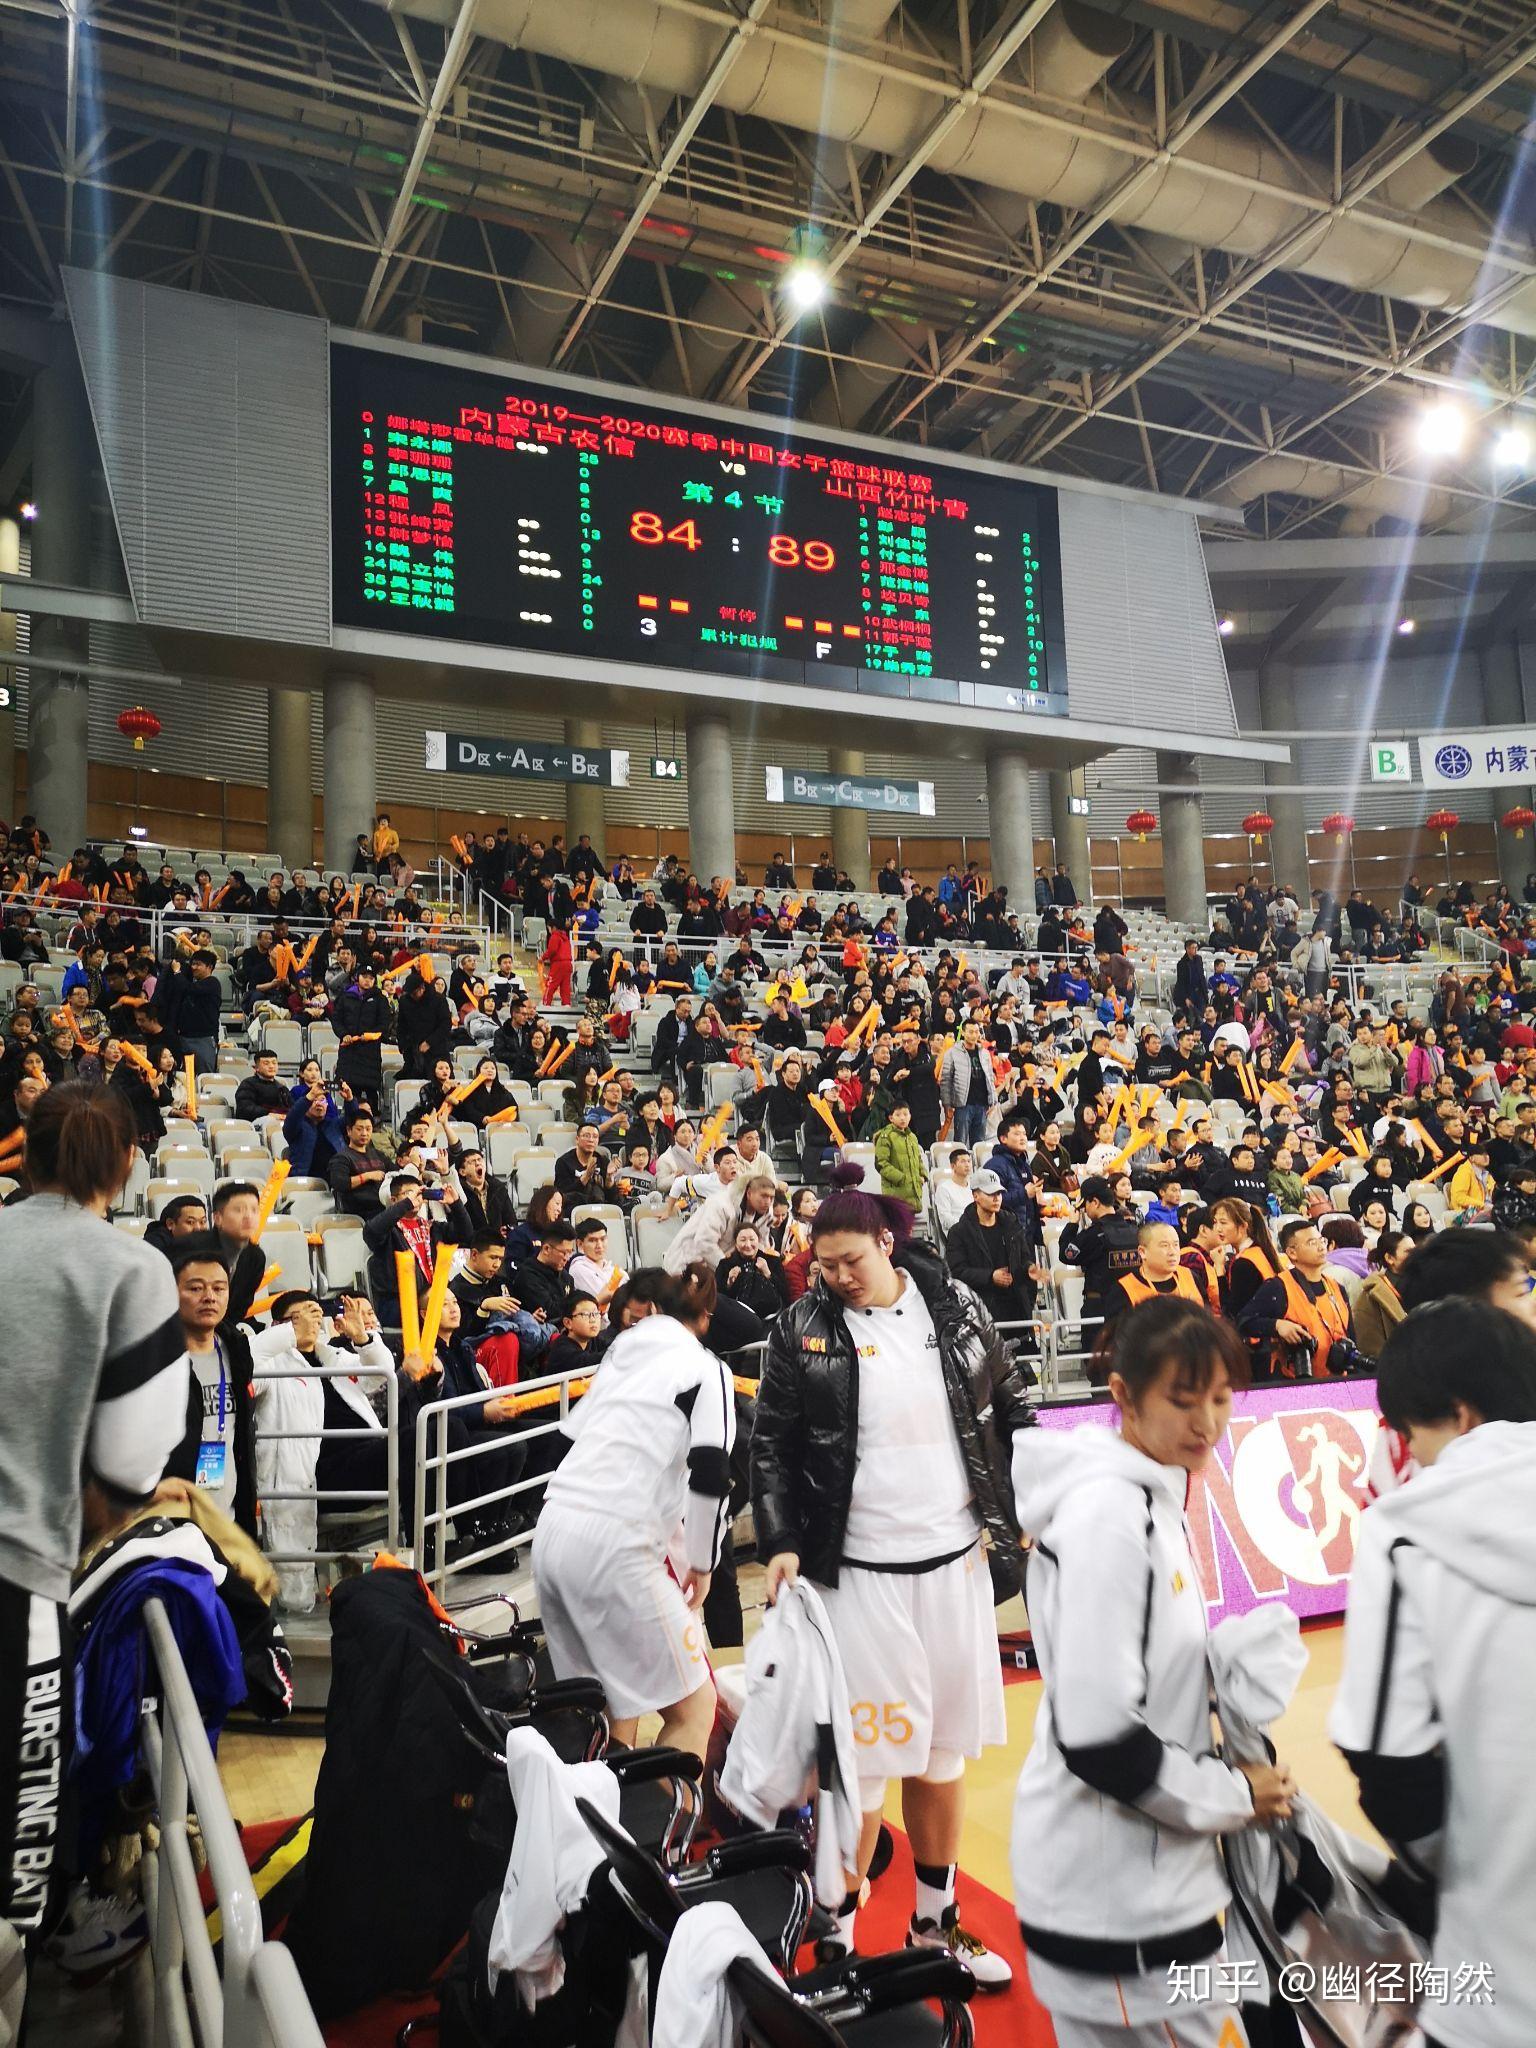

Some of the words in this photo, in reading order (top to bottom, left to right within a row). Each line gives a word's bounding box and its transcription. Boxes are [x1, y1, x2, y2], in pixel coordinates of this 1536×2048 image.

[362, 411, 373, 423] 0
[459, 405, 636, 458] 内蒙古农信
[363, 427, 371, 439] 1
[579, 467, 590, 478] 0
[362, 475, 374, 487] 7
[580, 512, 591, 524] 0
[580, 497, 590, 509] 2
[724, 491, 742, 508] 4
[754, 494, 784, 515] 节
[823, 478, 969, 520] 山西竹叶青
[859, 503, 866, 514] 1
[630, 510, 702, 551] 84
[768, 533, 837, 574] 89
[859, 531, 869, 542] 4
[580, 542, 591, 553] 9
[364, 539, 387, 554] 16
[582, 573, 603, 586] 24
[581, 558, 592, 569] 3
[363, 555, 387, 570] 24
[581, 588, 593, 599] 0
[861, 572, 871, 583] 7
[363, 588, 387, 602] 99
[582, 618, 594, 630] 0
[581, 603, 593, 614] 0
[640, 618, 657, 636] 3
[863, 615, 881, 627] 10
[864, 629, 880, 642] 11
[815, 642, 832, 659] F
[865, 643, 882, 655] 17
[1486, 745, 1536, 774] 内蒙
[851, 1701, 913, 1746] 35
[16, 1669, 62, 1840] BURSTING
